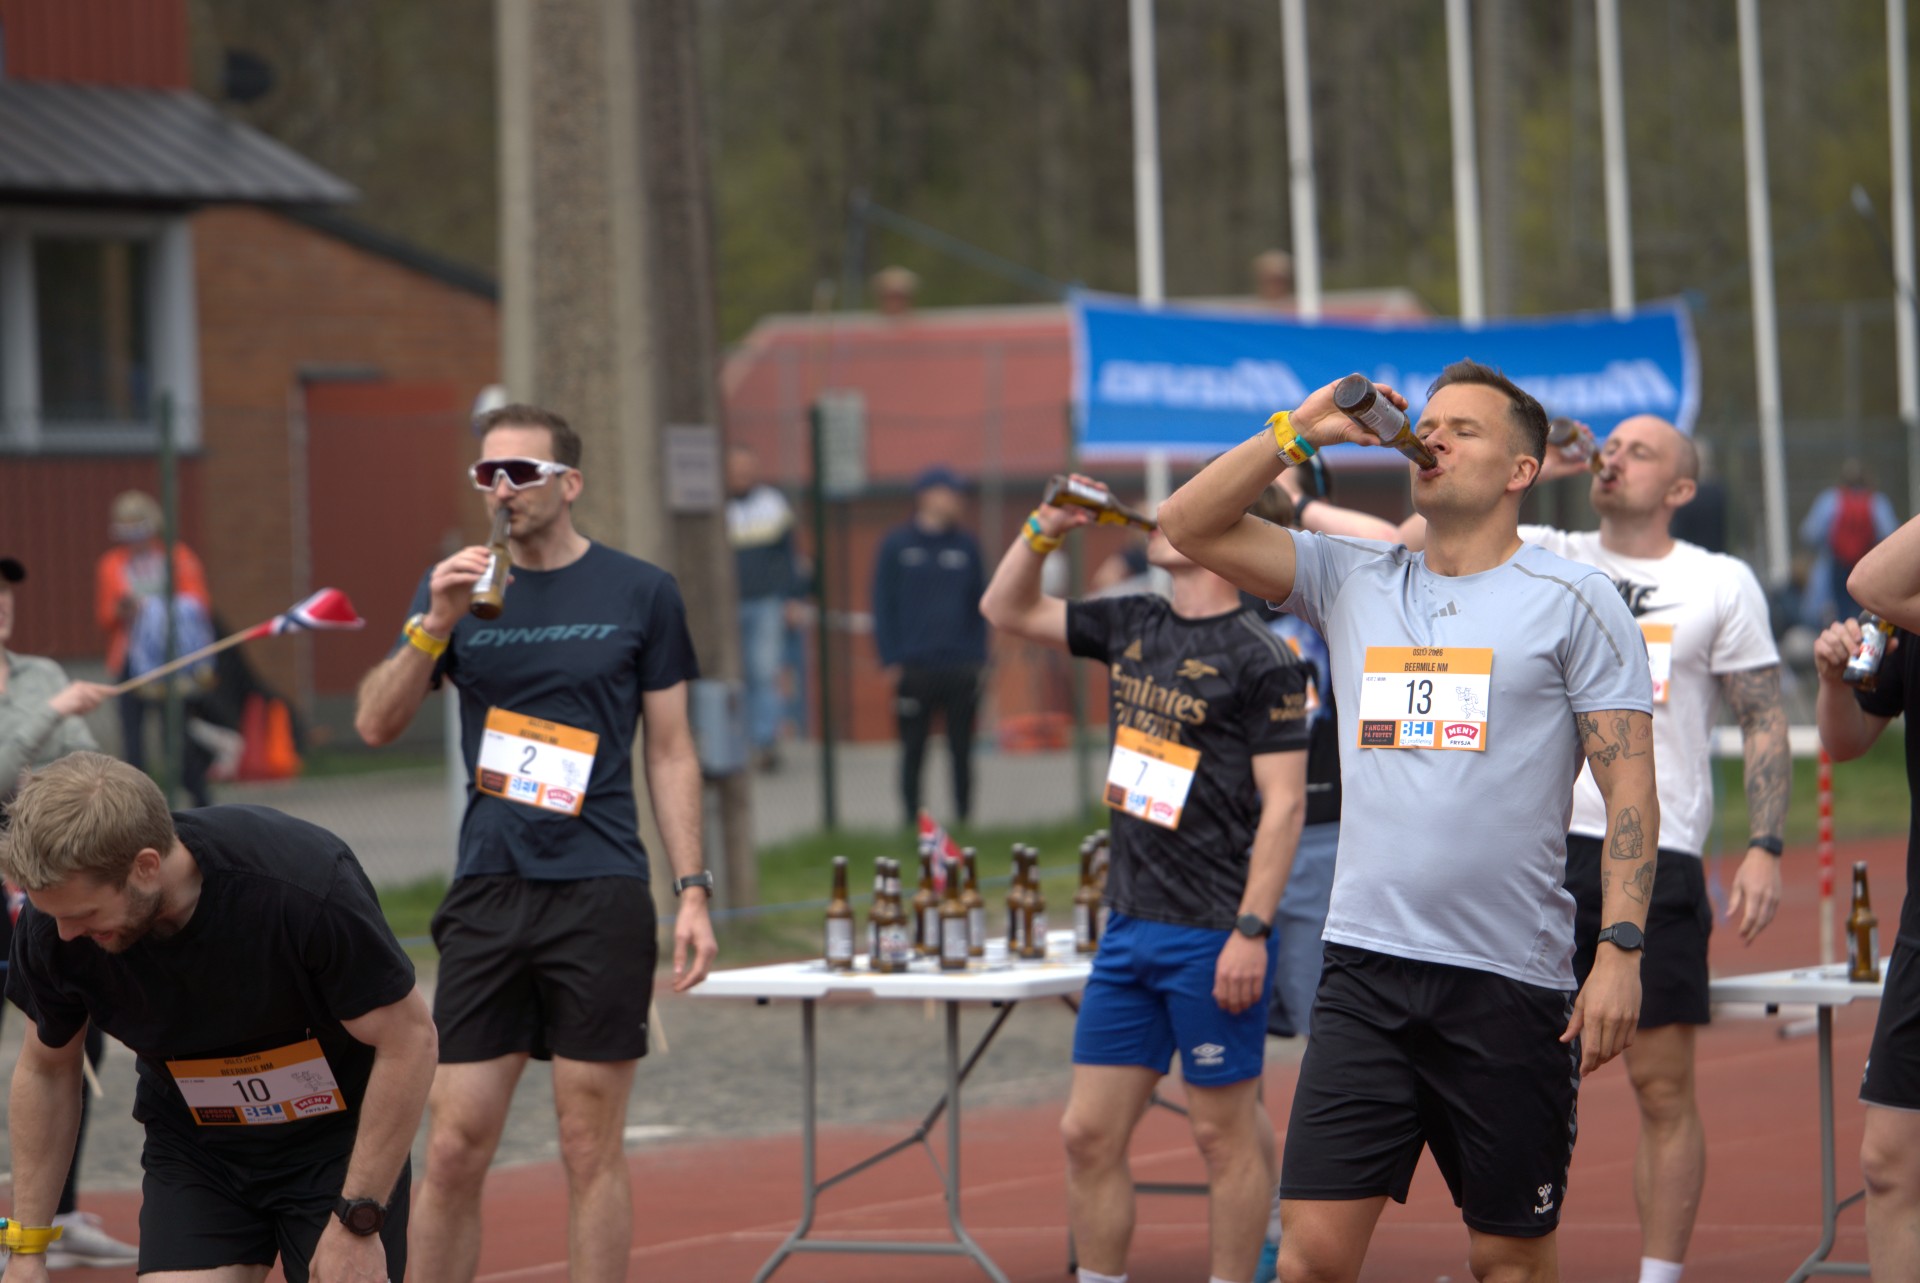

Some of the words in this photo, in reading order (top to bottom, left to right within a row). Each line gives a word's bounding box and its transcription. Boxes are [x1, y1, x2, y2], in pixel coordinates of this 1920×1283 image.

[467, 623, 619, 648] DYNAFIT
[1404, 662, 1436, 672] BEERMILE
[1437, 662, 1449, 672] NM
[1406, 679, 1433, 715] 13
[1364, 723, 1393, 732] FANGENE
[1402, 721, 1434, 737] BEL
[1448, 726, 1475, 736] MENY
[518, 745, 537, 775] 2
[1135, 760, 1149, 786] 7
[220, 1065, 260, 1076] BEERMILE
[260, 1061, 274, 1072] NM
[232, 1078, 271, 1103] 10
[302, 1096, 329, 1107] MENY
